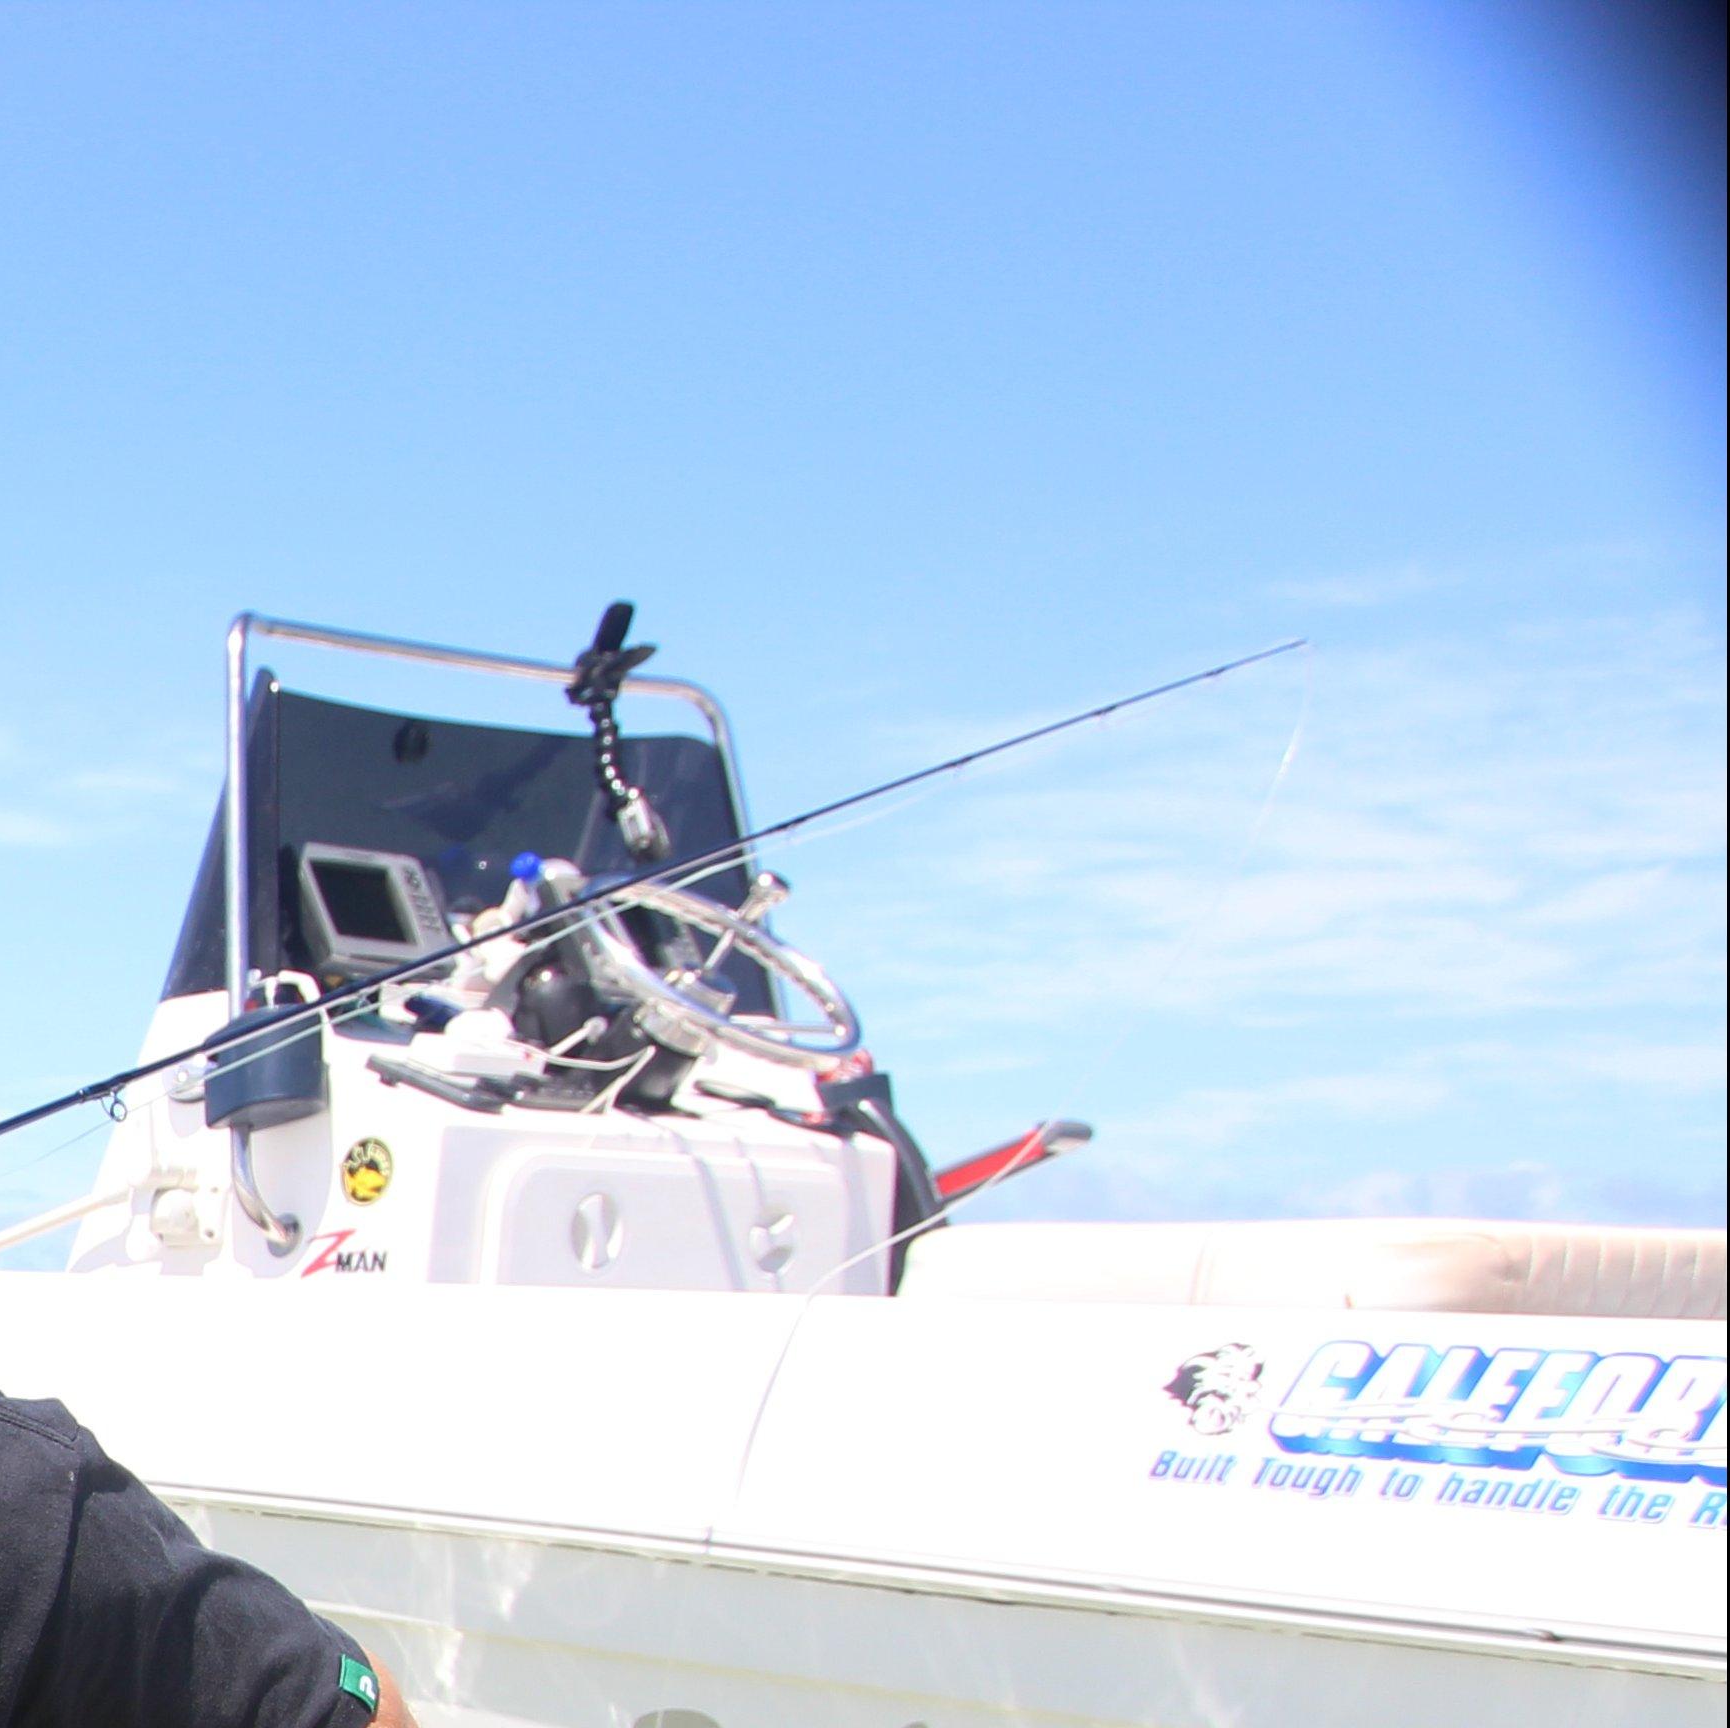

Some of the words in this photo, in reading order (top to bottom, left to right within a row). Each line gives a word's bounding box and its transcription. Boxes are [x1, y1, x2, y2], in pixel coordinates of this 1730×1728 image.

[1149, 1449, 1237, 1483] Built
[1252, 1459, 1363, 1497] Tough
[1379, 1466, 1423, 1500] to
[1435, 1471, 1578, 1515] handle
[1596, 1485, 1675, 1523] the
